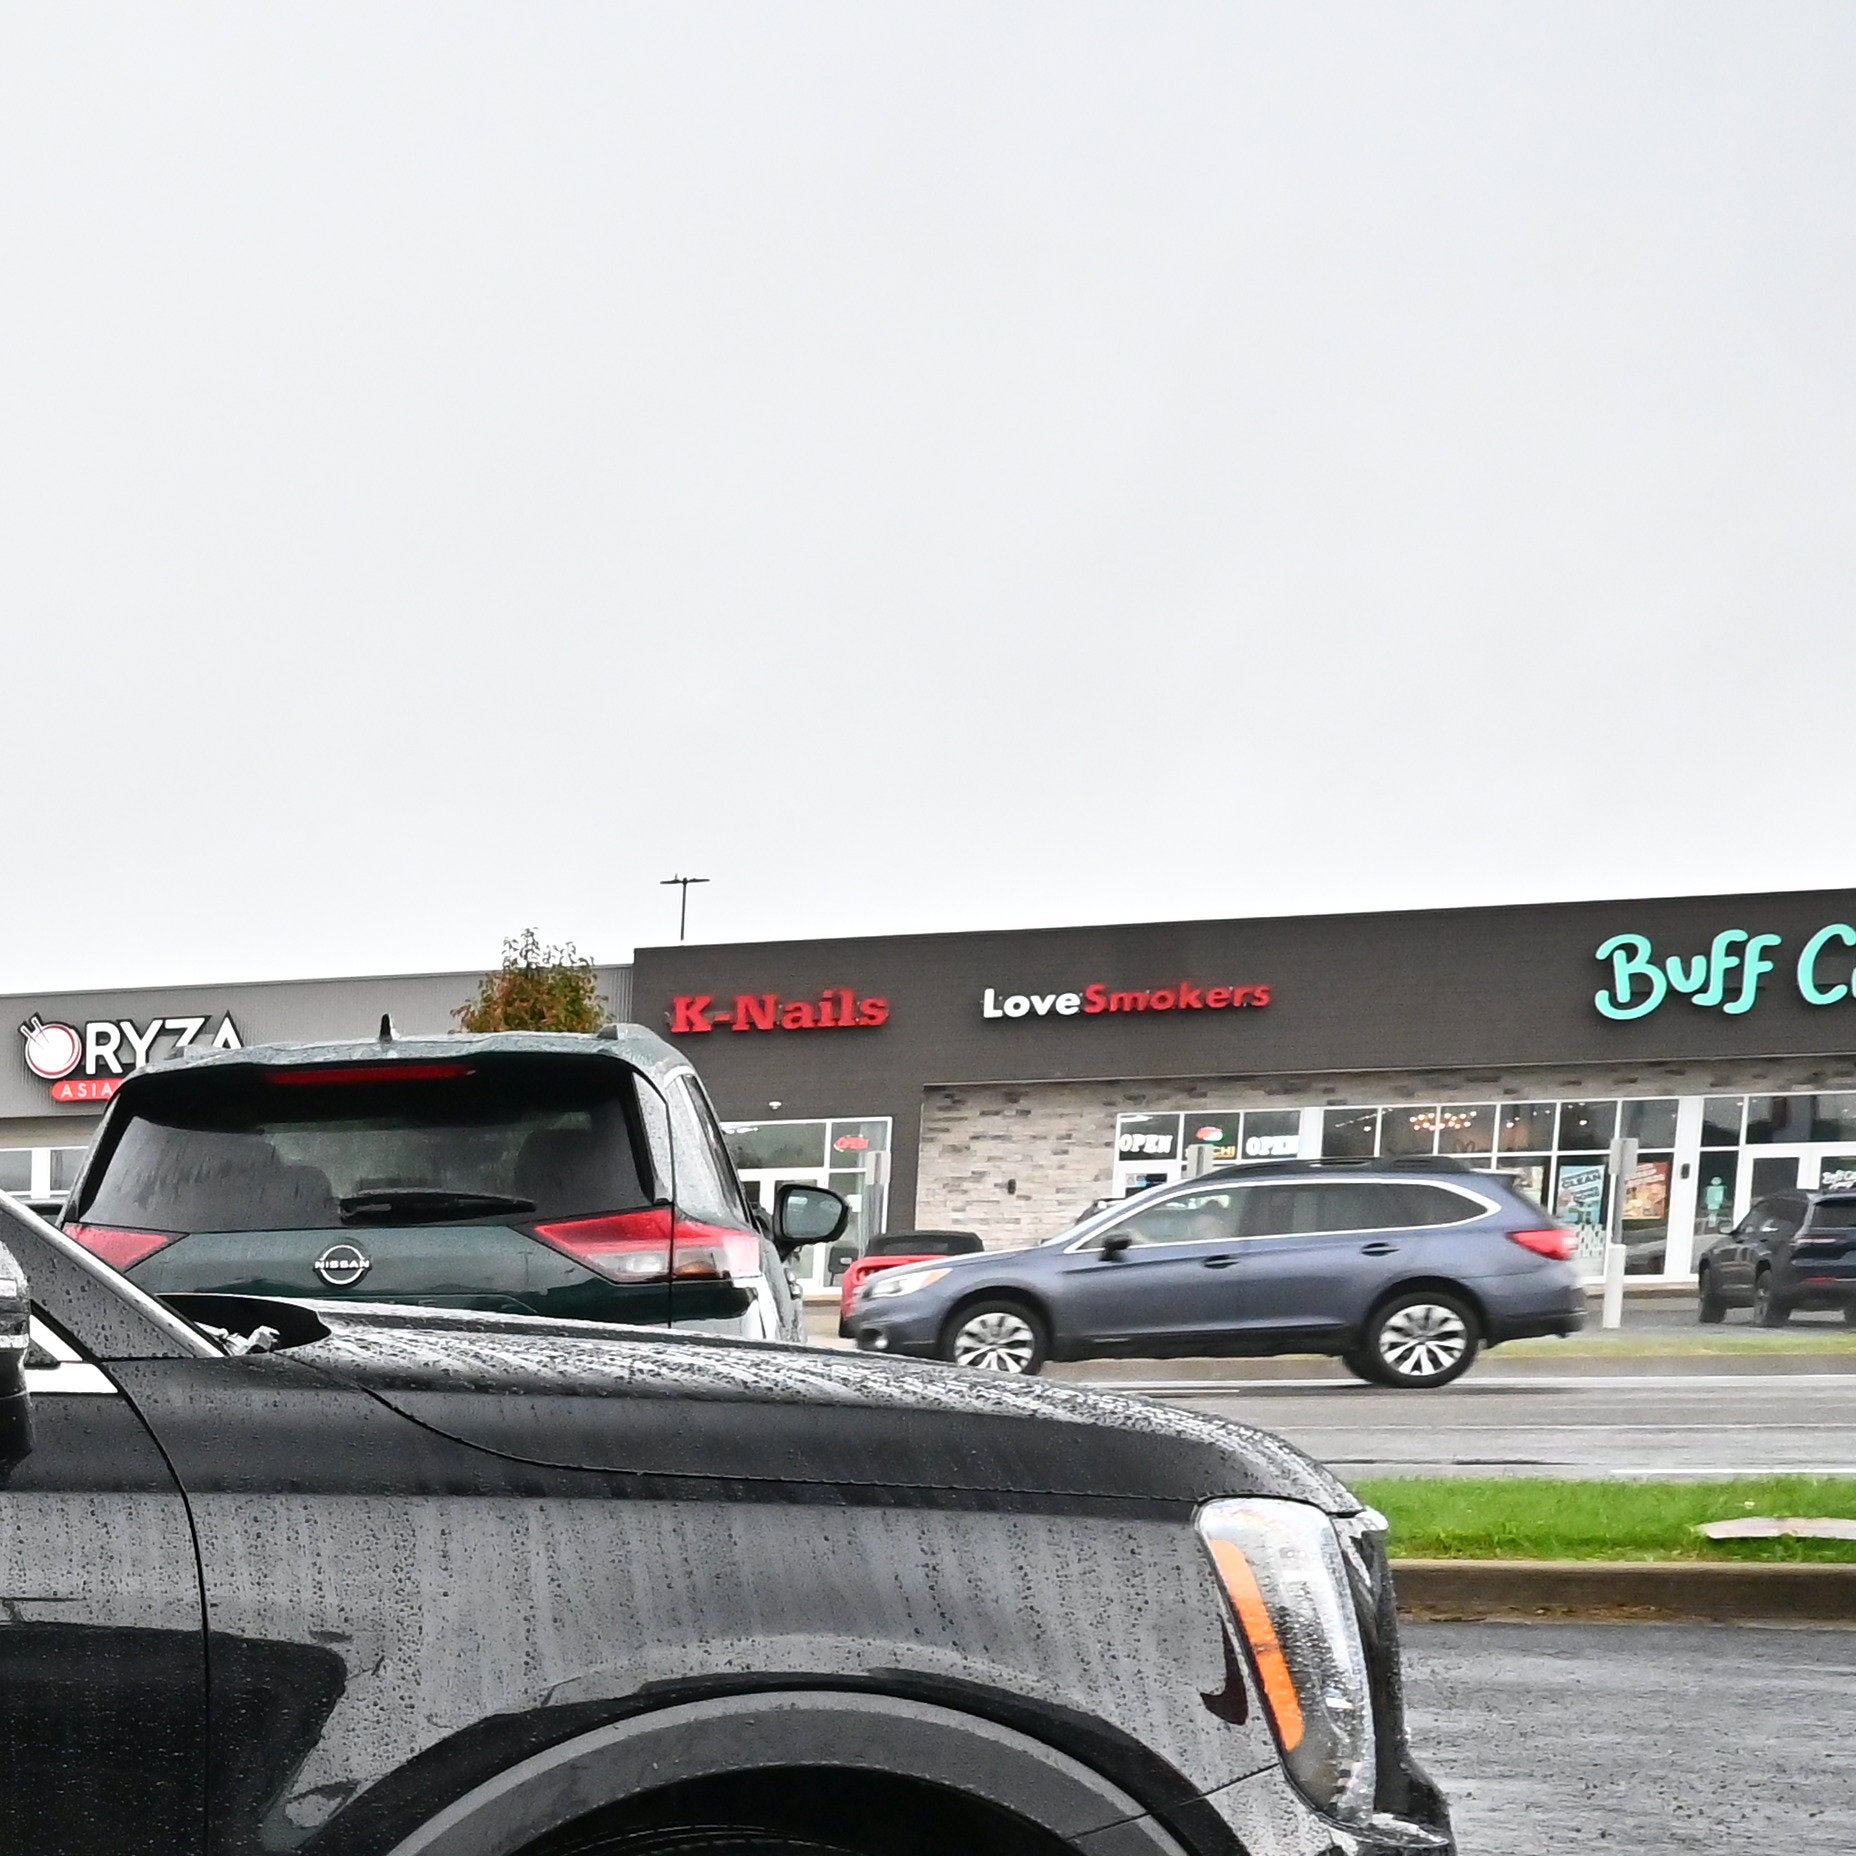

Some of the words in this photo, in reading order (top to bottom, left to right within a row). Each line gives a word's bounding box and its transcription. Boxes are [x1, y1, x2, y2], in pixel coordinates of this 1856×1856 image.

[1595, 929, 1782, 1020] Buff
[669, 988, 889, 1033] K-Nails
[60, 1082, 123, 1098] ASIA
[314, 1260, 370, 1269] NISSAN
